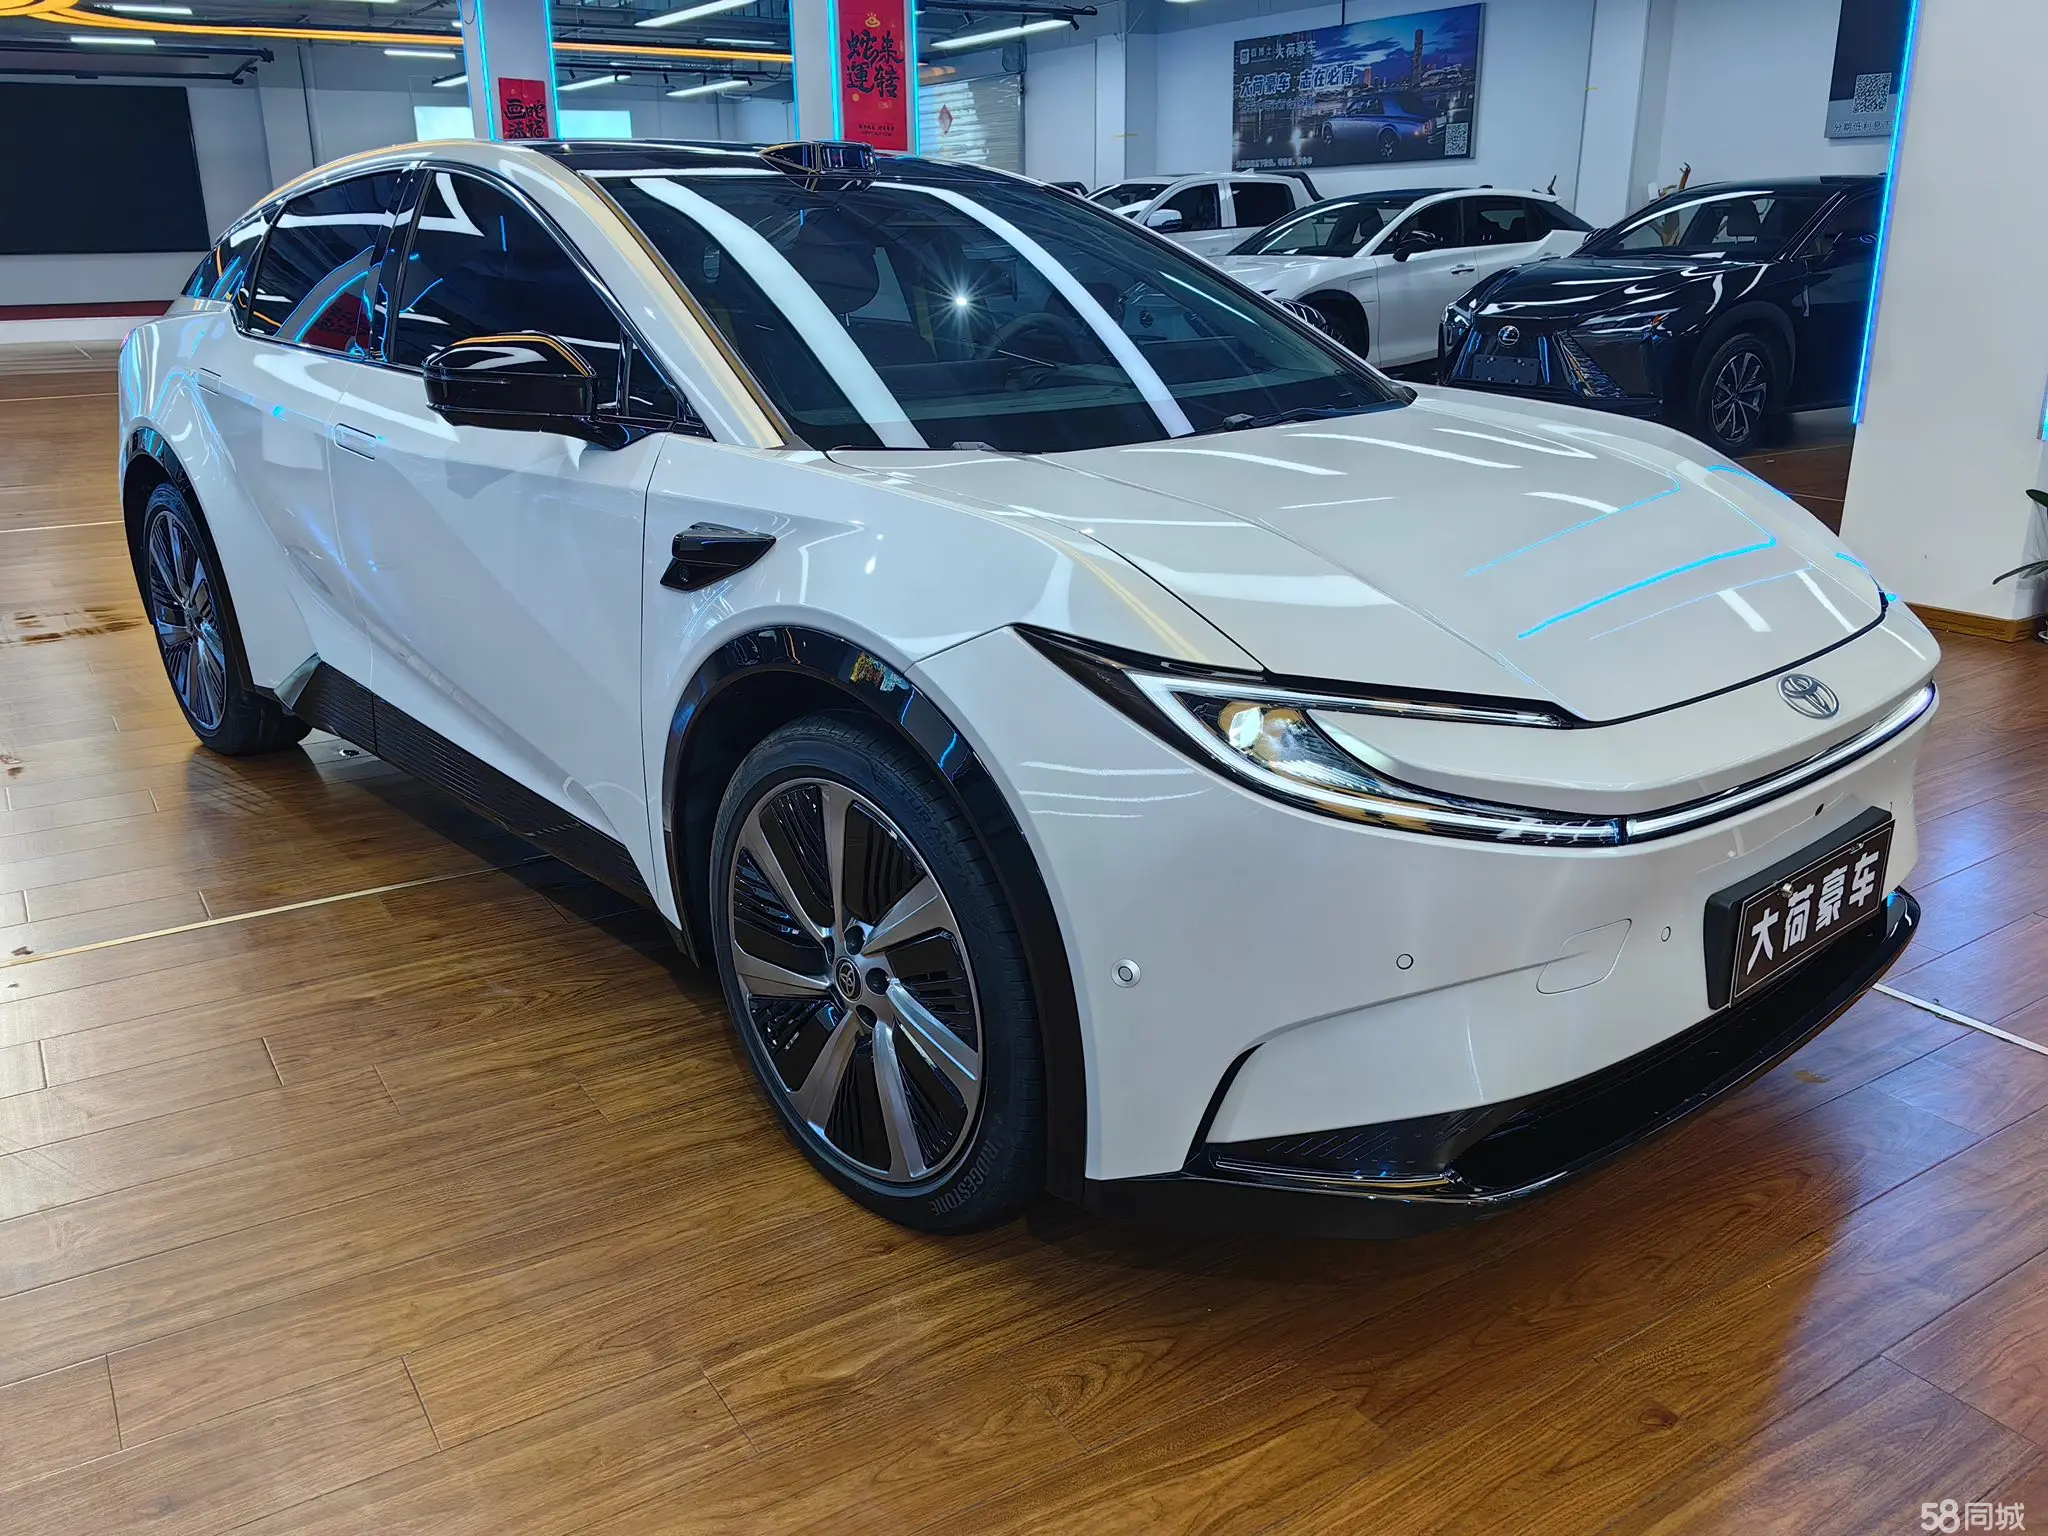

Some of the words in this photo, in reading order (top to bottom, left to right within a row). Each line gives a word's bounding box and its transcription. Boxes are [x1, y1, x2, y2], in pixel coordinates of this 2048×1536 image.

[1239, 72, 1292, 98] 大荷豪车
[1298, 65, 1356, 90] 志在必得
[1746, 850, 1879, 976] 大荷豪车
[927, 1134, 1004, 1217] RIDGESTONE
